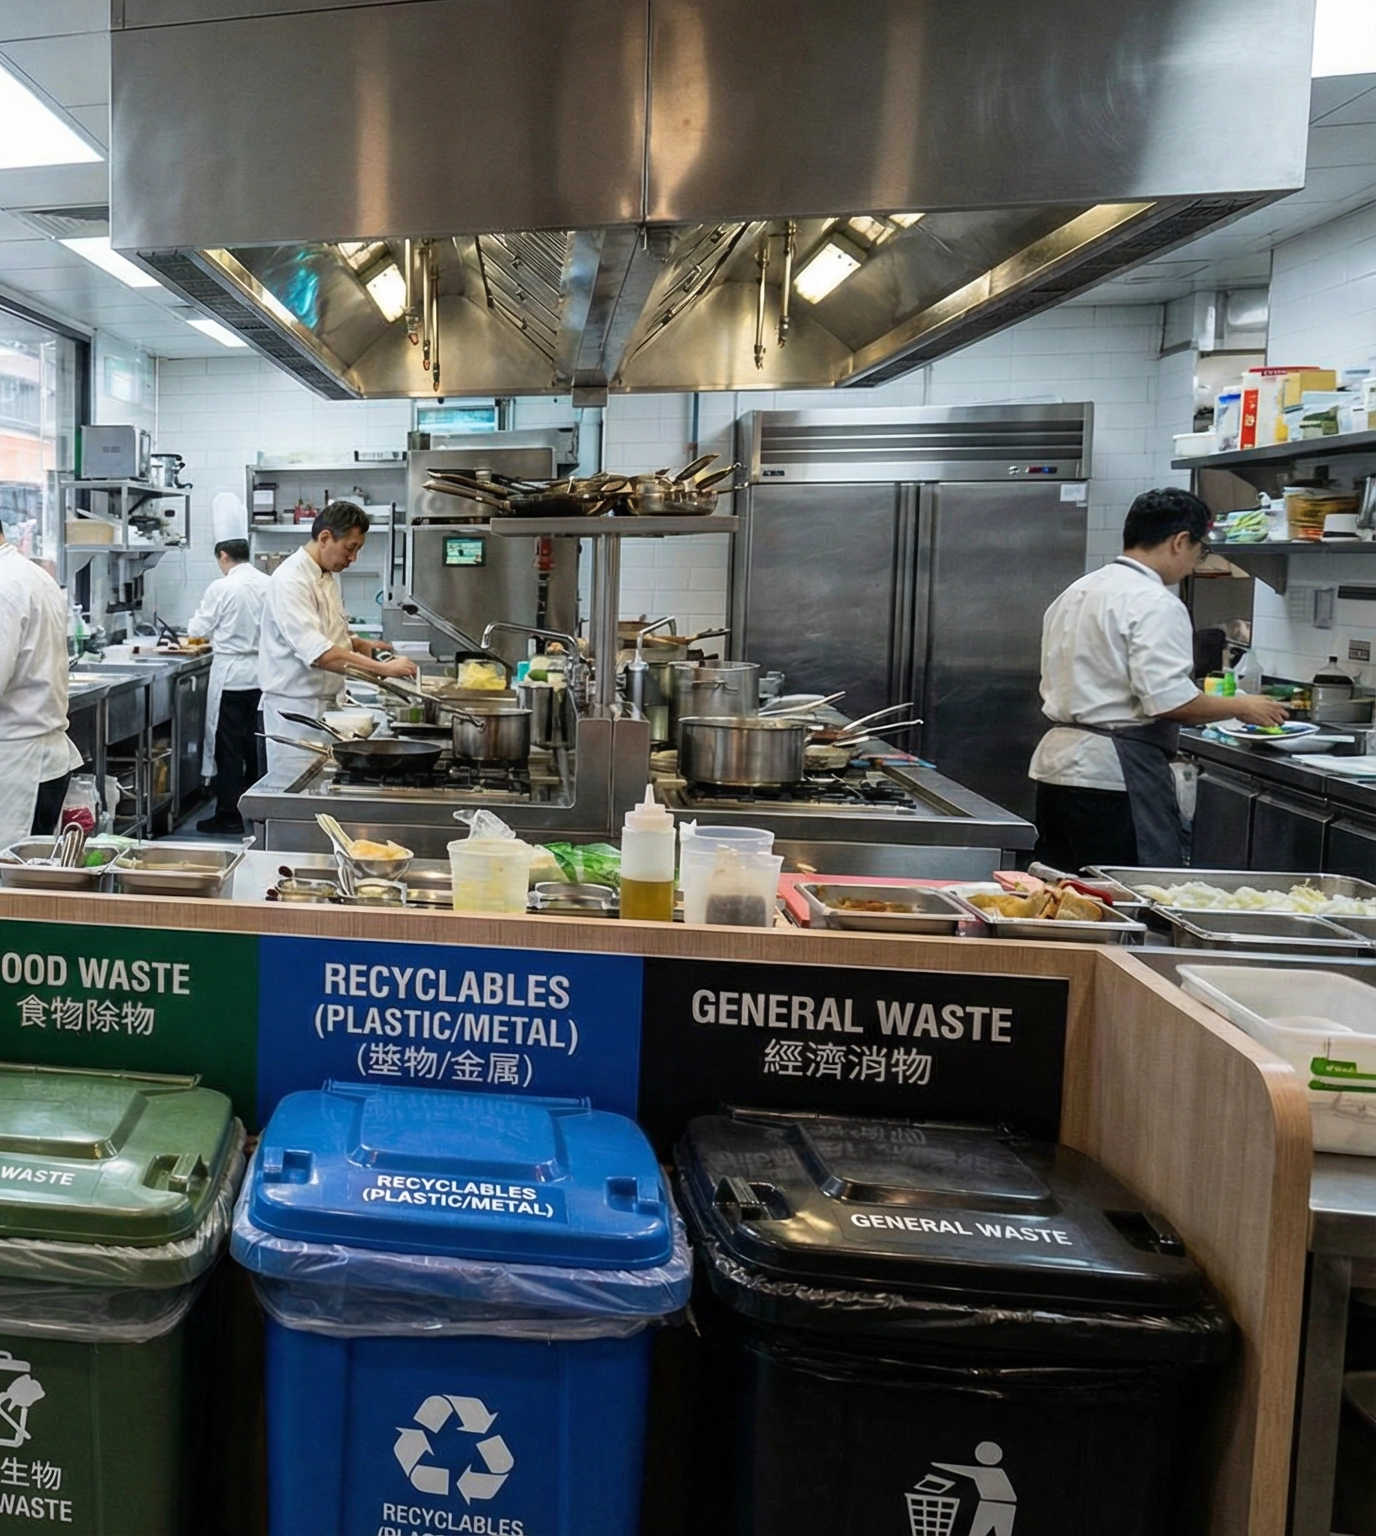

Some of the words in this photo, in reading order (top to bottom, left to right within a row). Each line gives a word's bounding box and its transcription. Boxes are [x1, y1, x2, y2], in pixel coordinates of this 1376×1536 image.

[78, 956, 190, 995] WASTE
[324, 962, 570, 1010] RECYCLABLES
[17, 994, 155, 1036] 食物除物
[315, 1004, 579, 1056] (PLASTIC/METAL)
[692, 989, 863, 1033] GENERAL
[877, 1000, 1013, 1043] WASTE
[0, 1166, 75, 1186] WASTE
[377, 1175, 537, 1201] RECYCLABLES
[362, 1188, 554, 1218] (PLASTIC/METAL)
[851, 1213, 973, 1236] GENERAL
[975, 1222, 1073, 1246] WASTE
[383, 1502, 524, 1536] RECYCLABLES
